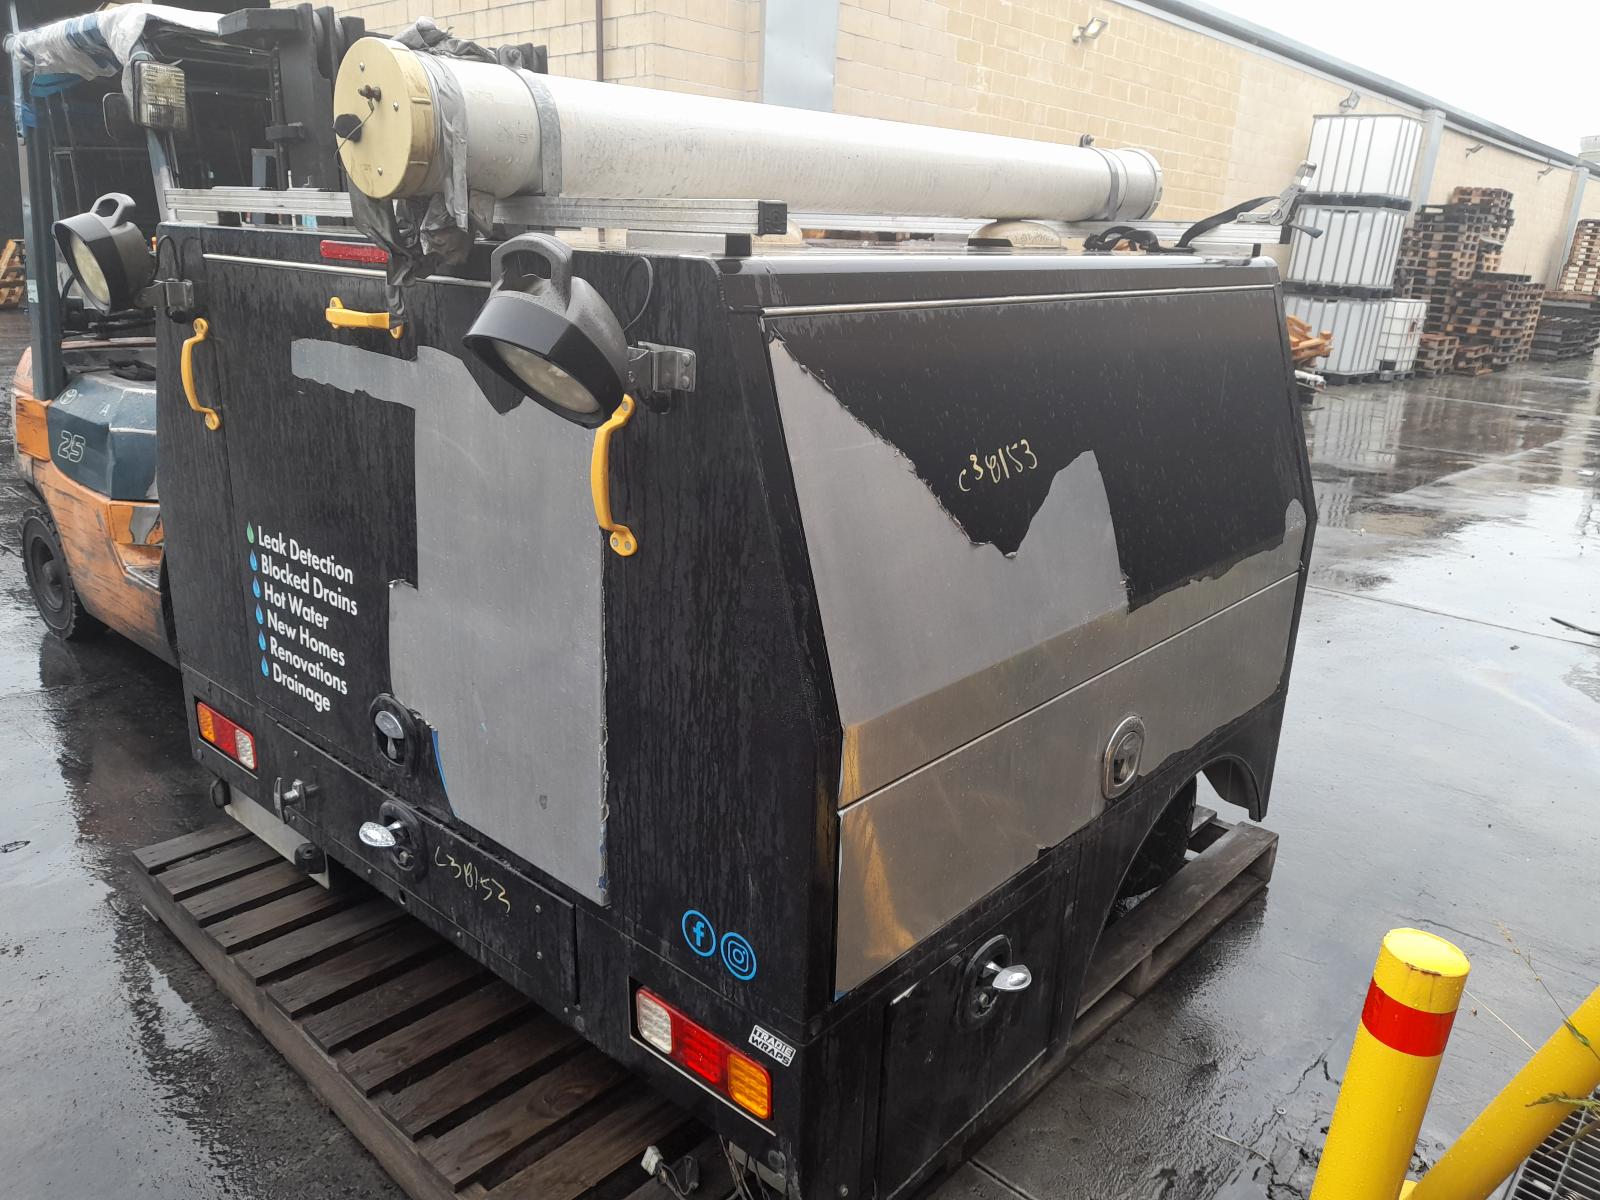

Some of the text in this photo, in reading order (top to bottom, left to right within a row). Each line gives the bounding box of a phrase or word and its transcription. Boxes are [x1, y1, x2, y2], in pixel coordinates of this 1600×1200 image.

[57, 429, 86, 463] 25
[257, 525, 354, 585] Leak Detection
[261, 553, 358, 616] Blocked Drains
[264, 581, 329, 630] Hot Water
[267, 608, 346, 667] New Homes
[269, 635, 348, 695] Renovations
[272, 662, 331, 712] Drainage
[750, 1035, 791, 1065] WRAPS
[753, 1026, 795, 1058] TRADIE
